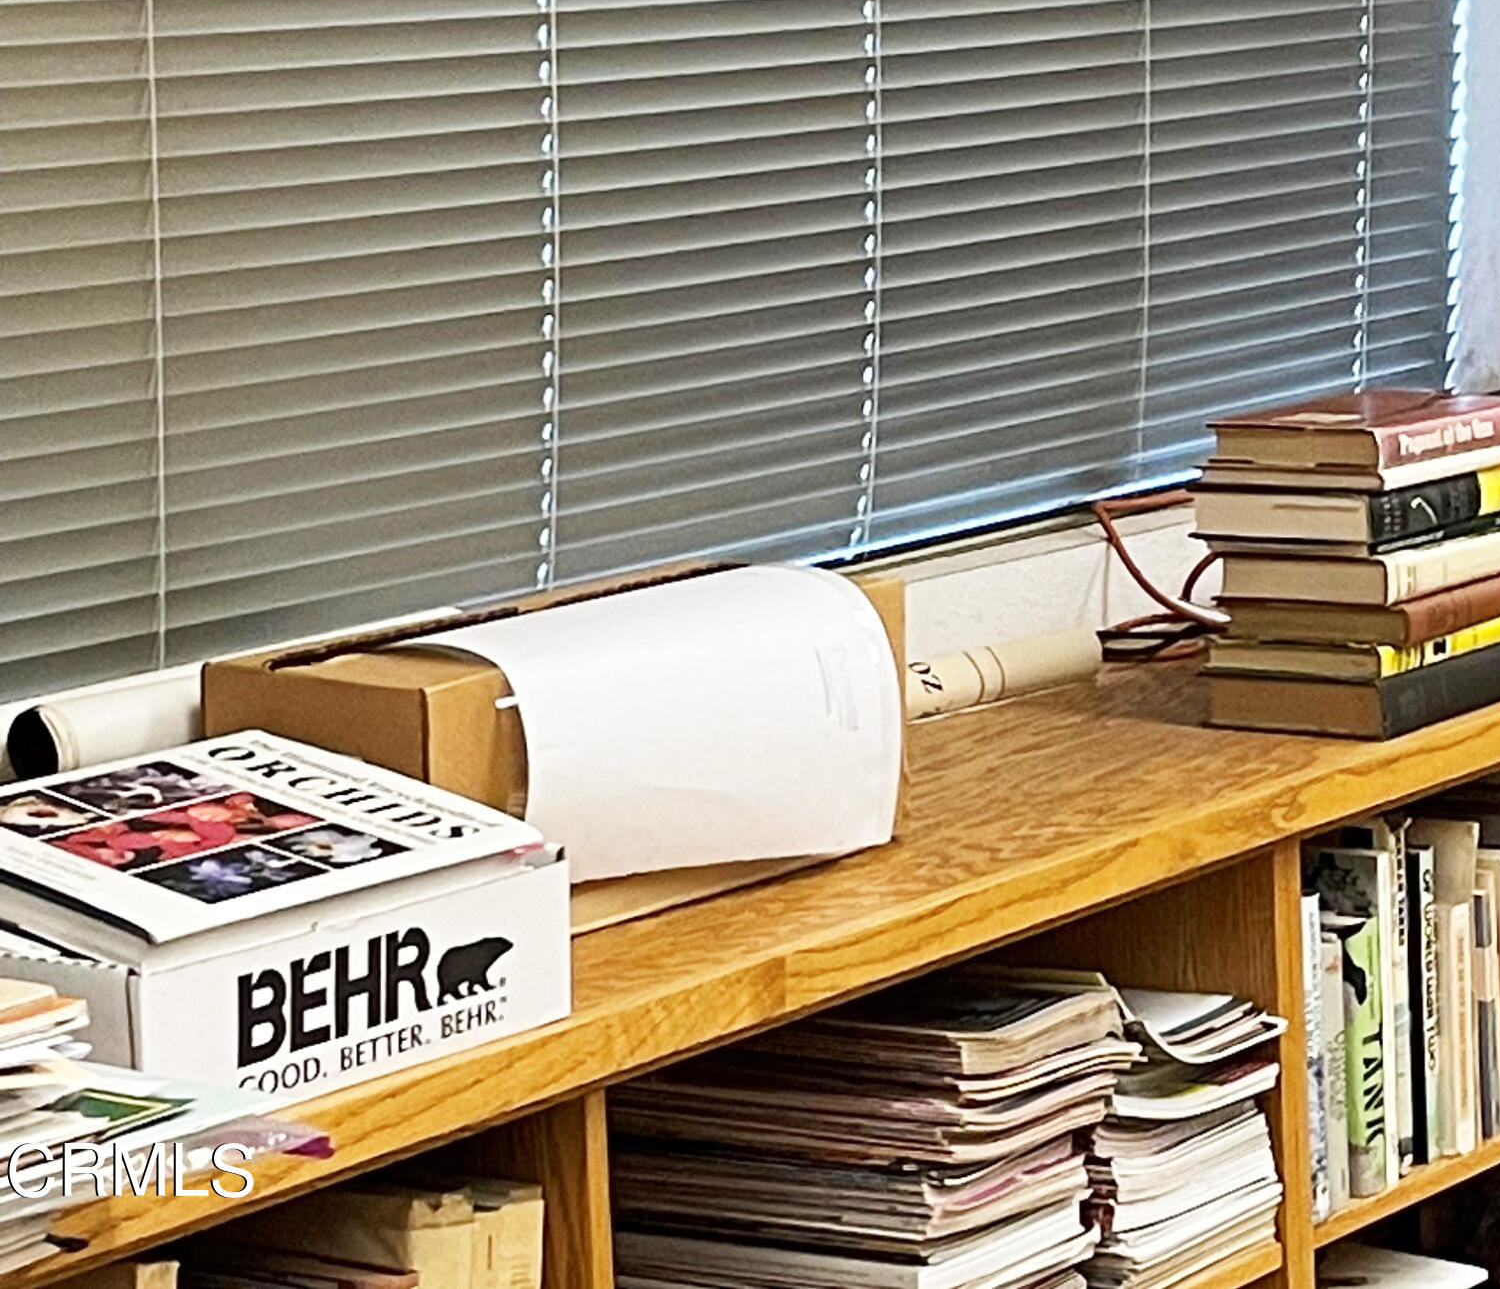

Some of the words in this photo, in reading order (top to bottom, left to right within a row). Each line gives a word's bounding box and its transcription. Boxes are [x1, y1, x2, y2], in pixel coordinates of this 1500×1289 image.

[207, 745, 480, 840] ORCHIDS
[237, 926, 433, 1070] BEHR
[340, 1023, 432, 1072] BETTER.
